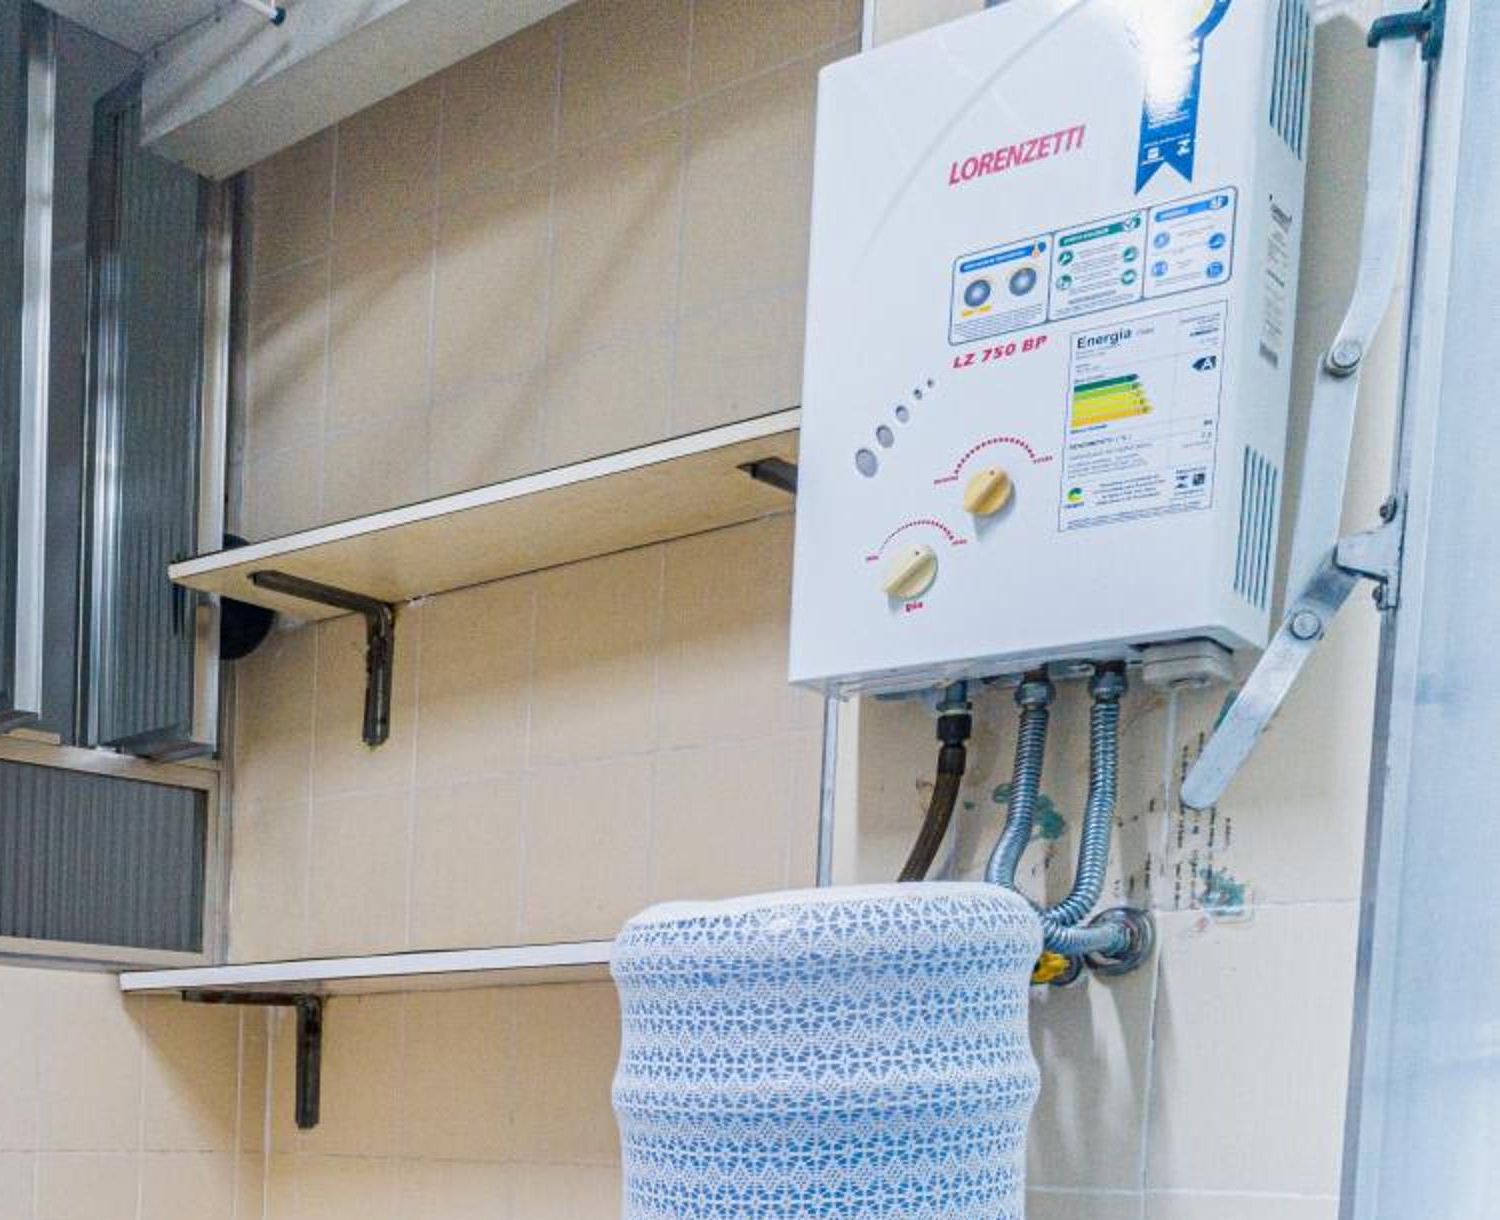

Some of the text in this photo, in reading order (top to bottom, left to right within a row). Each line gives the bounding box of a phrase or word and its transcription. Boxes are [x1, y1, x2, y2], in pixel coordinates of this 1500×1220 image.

[949, 124, 1086, 186] LORENZETTI
[953, 335, 1047, 369] LZ 750 BP
[1077, 327, 1132, 349] Energia
